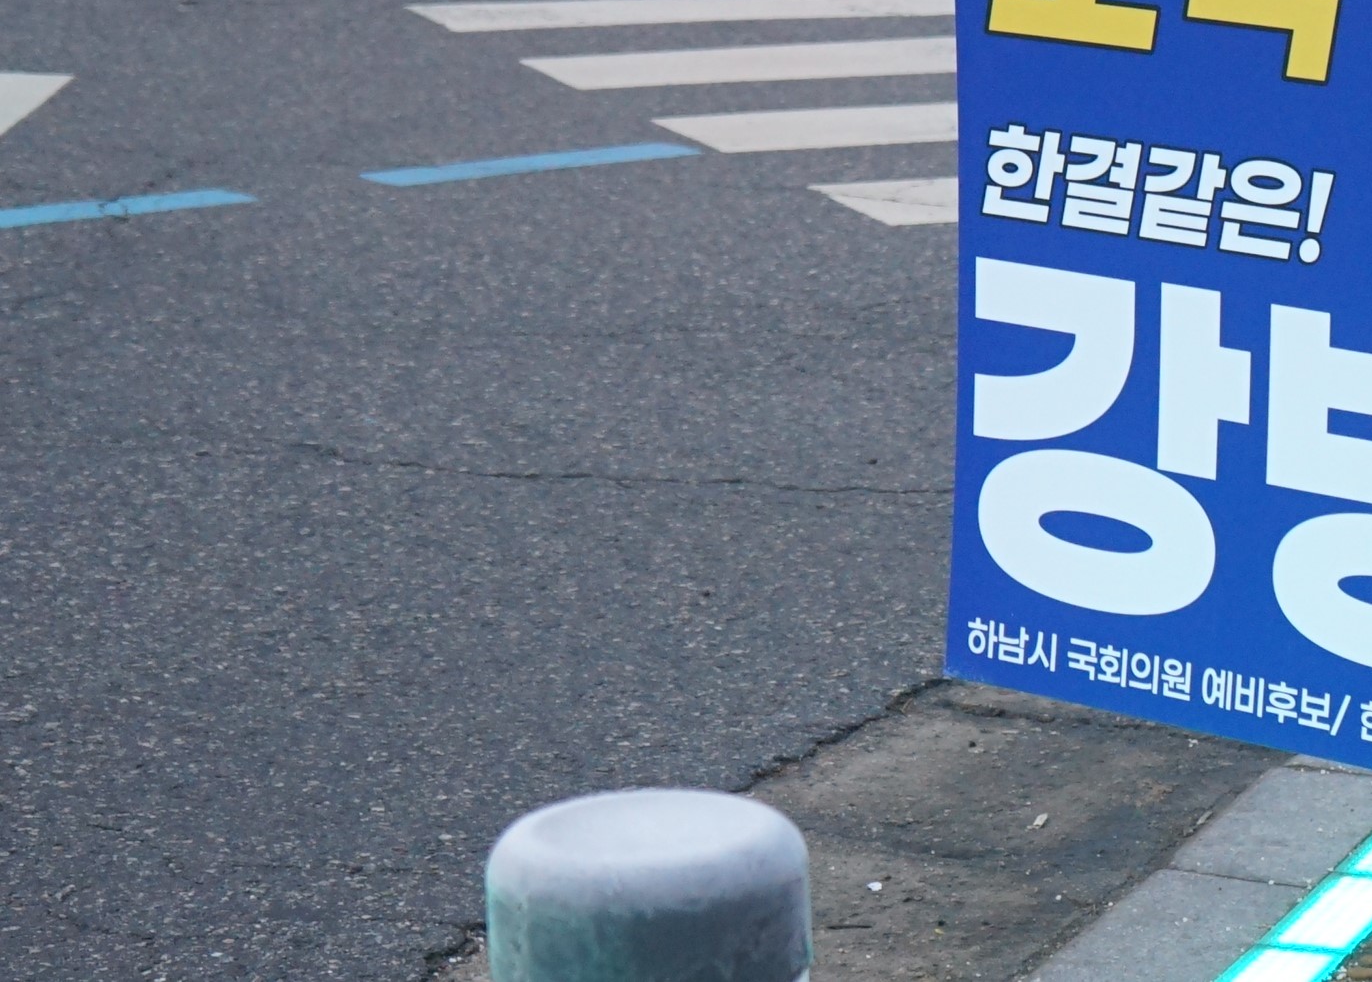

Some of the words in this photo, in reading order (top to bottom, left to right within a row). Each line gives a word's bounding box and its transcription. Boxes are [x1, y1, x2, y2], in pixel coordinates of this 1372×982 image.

[981, 122, 1335, 264] 한결같은!
[967, 617, 1057, 672] 하남시
[1067, 637, 1191, 702] 국회의원
[1200, 666, 1351, 736] 예비후보/
